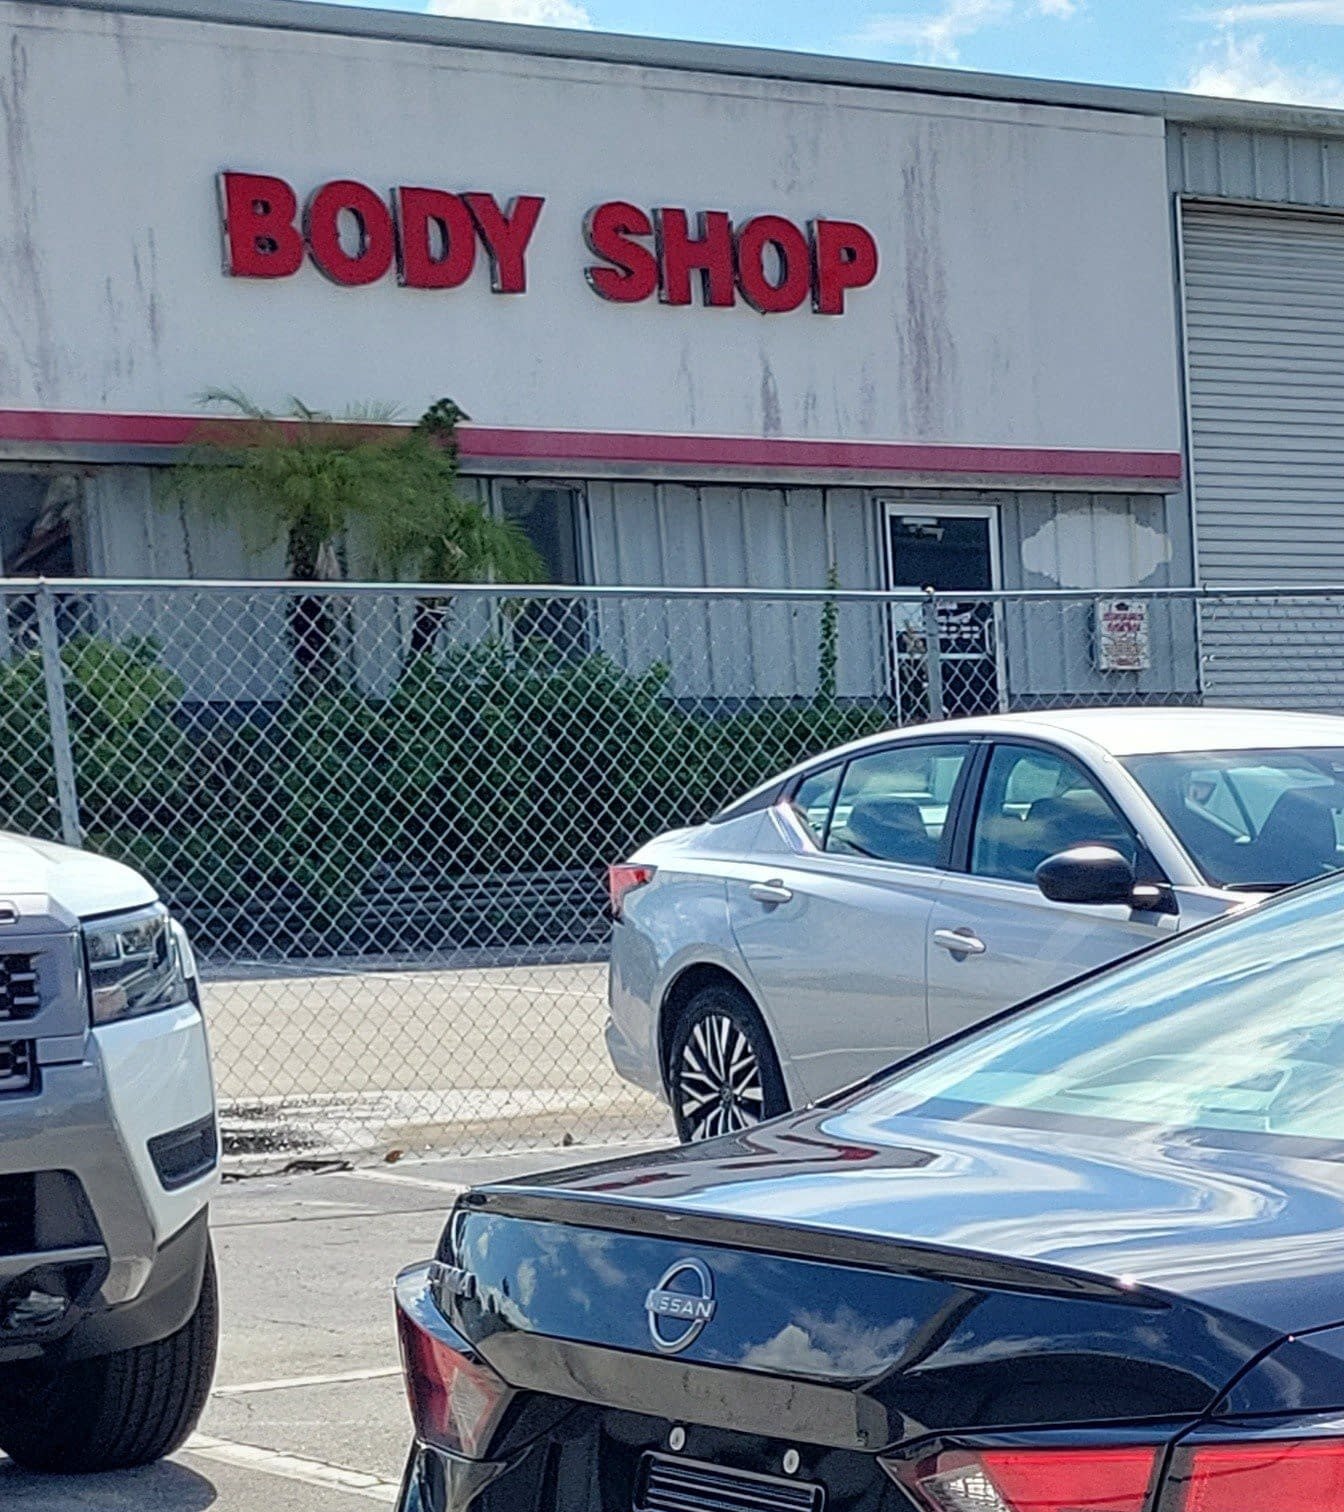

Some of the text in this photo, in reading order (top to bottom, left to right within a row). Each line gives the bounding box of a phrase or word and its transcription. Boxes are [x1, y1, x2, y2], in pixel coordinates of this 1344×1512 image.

[217, 171, 879, 316] BODY SHOP
[650, 1293, 712, 1317] SSAN
